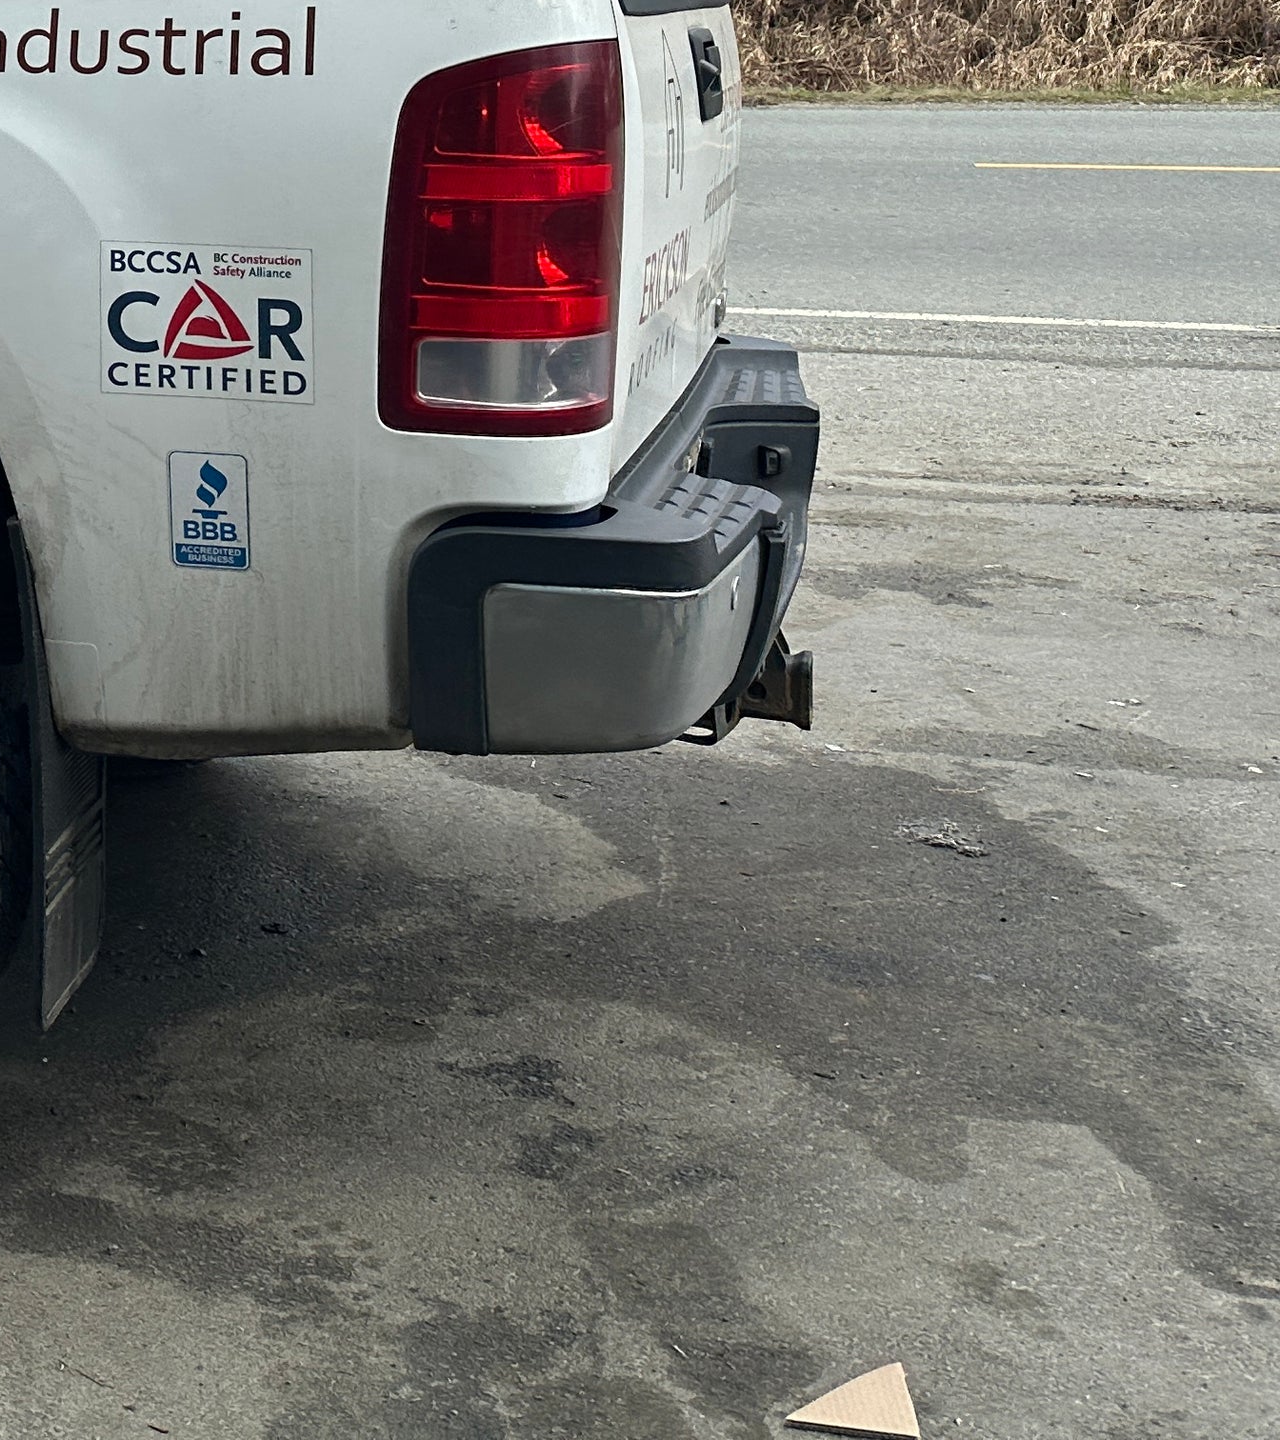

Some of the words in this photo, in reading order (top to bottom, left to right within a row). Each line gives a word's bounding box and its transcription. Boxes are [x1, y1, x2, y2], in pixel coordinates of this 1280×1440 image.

[109, 249, 202, 275] BCCSA
[213, 252, 230, 264] BC
[231, 253, 302, 267] Construction
[212, 265, 246, 279] Safety
[248, 266, 292, 279] Alliance
[107, 362, 307, 396] CERTIFIED
[183, 519, 238, 542] BBB
[180, 545, 242, 557] ACCREDITED
[188, 553, 235, 564] BUSINESS
